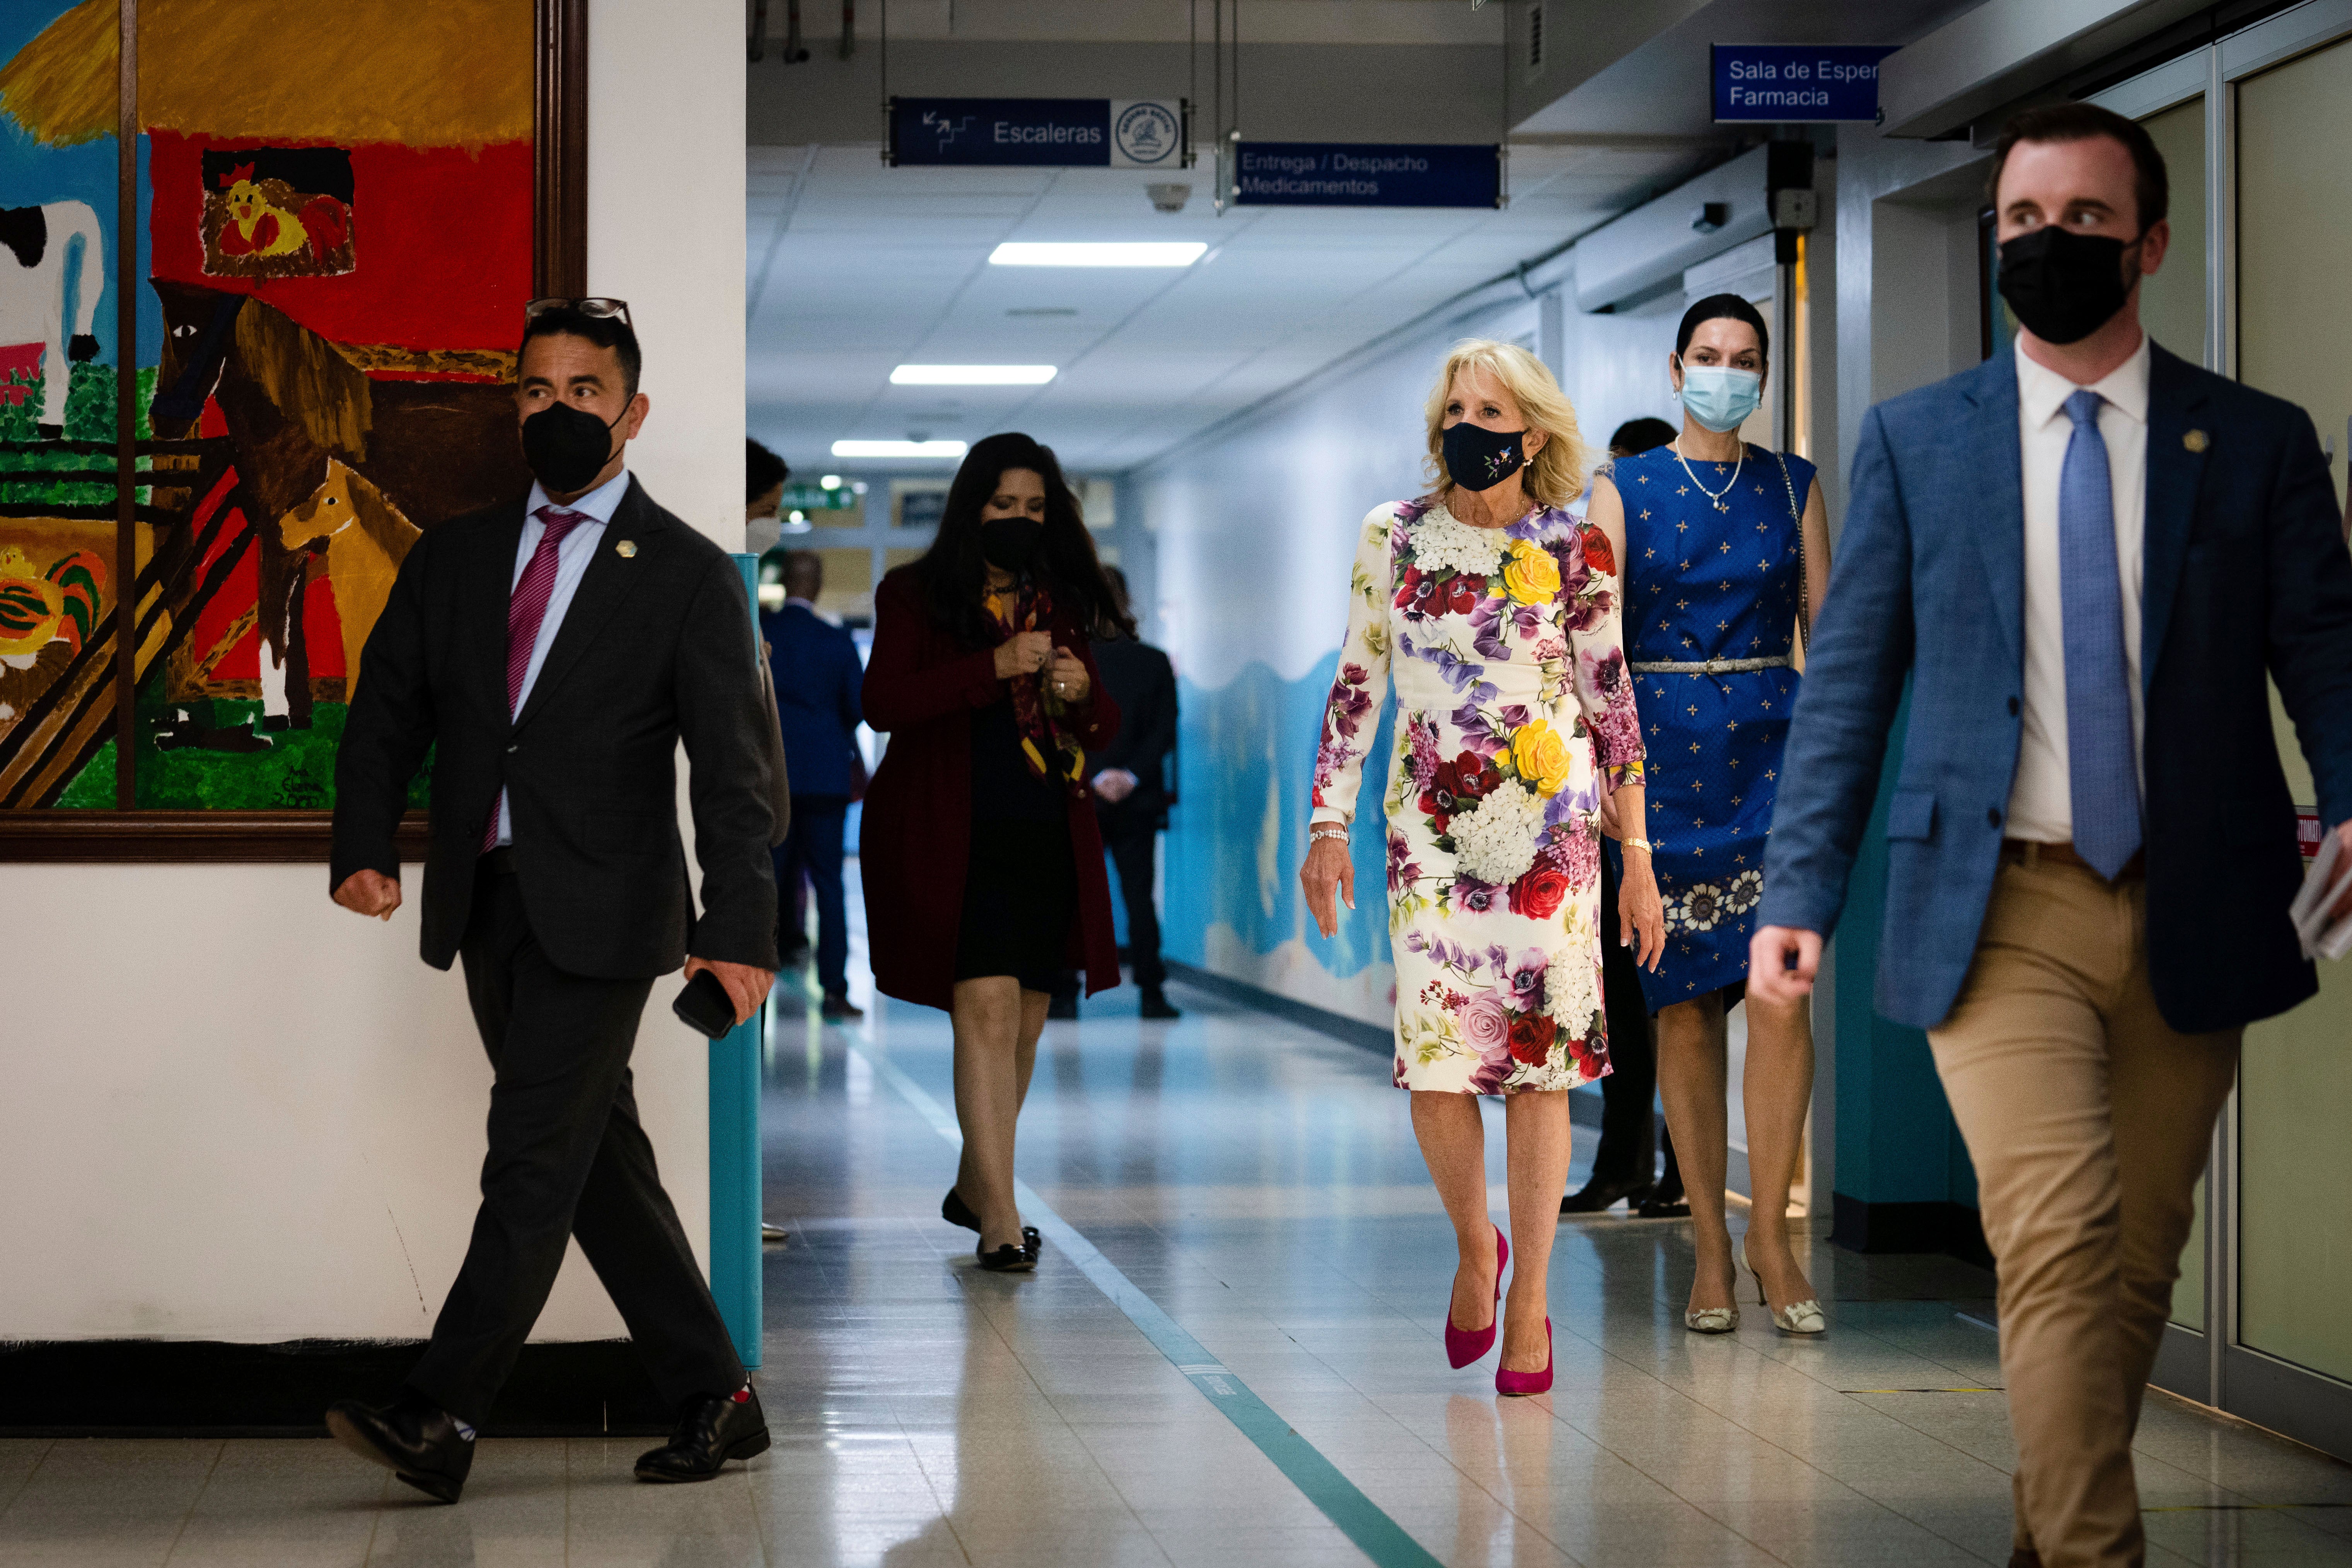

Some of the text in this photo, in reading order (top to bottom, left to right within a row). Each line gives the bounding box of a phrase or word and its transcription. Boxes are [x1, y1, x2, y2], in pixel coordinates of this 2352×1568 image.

[1729, 60, 1880, 84] Sala de Esper
[1730, 86, 1829, 106] Farmacia
[994, 121, 1102, 143] Escaleras
[1242, 153, 1429, 175] Entrega / Despacho
[1242, 176, 1380, 195] Medicamentos
[2297, 819, 2321, 842] UTOMATI
